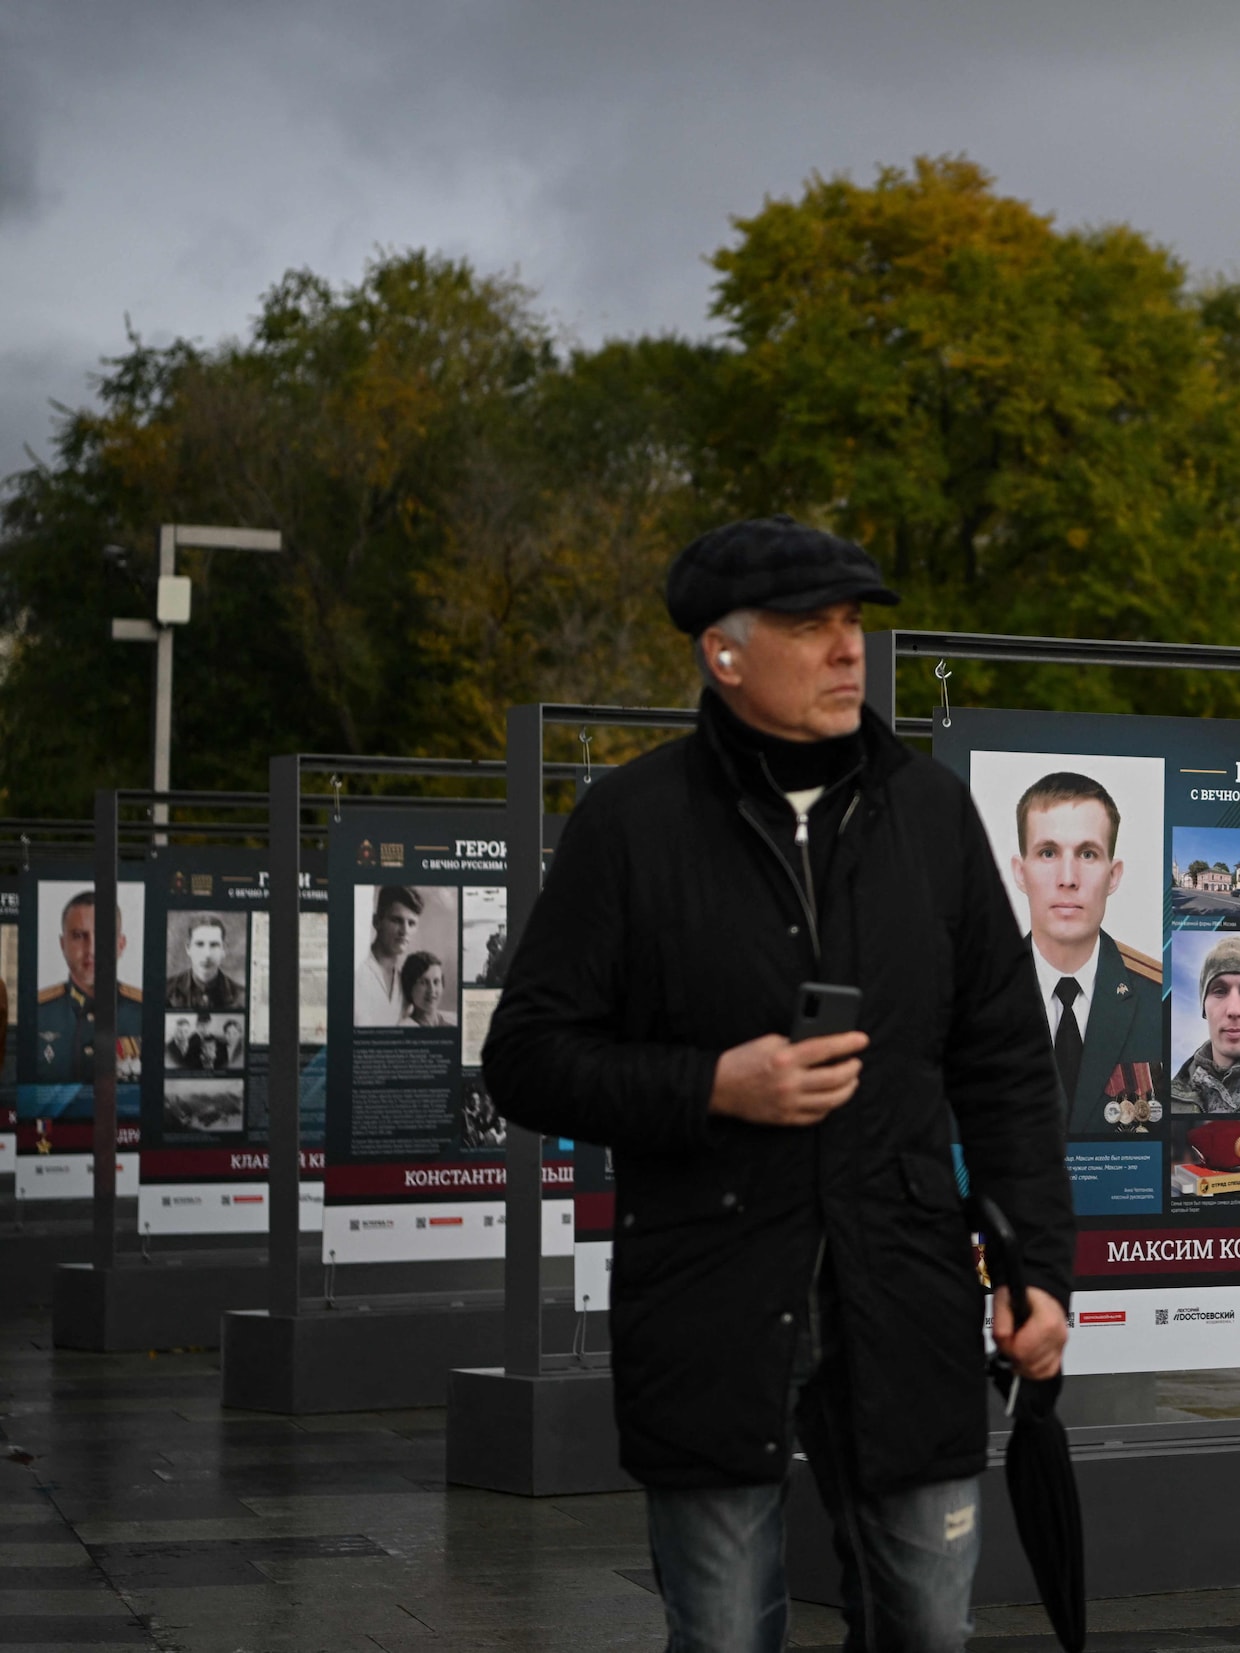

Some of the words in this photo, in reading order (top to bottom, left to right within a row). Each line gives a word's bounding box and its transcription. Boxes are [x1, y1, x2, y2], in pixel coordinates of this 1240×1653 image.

[1191, 789, 1198, 800] С
[1201, 790, 1240, 802] ВЕЧНО
[405, 1168, 506, 1187] КОНСТАНТИ
[1107, 1239, 1214, 1263] МАКСИМ
